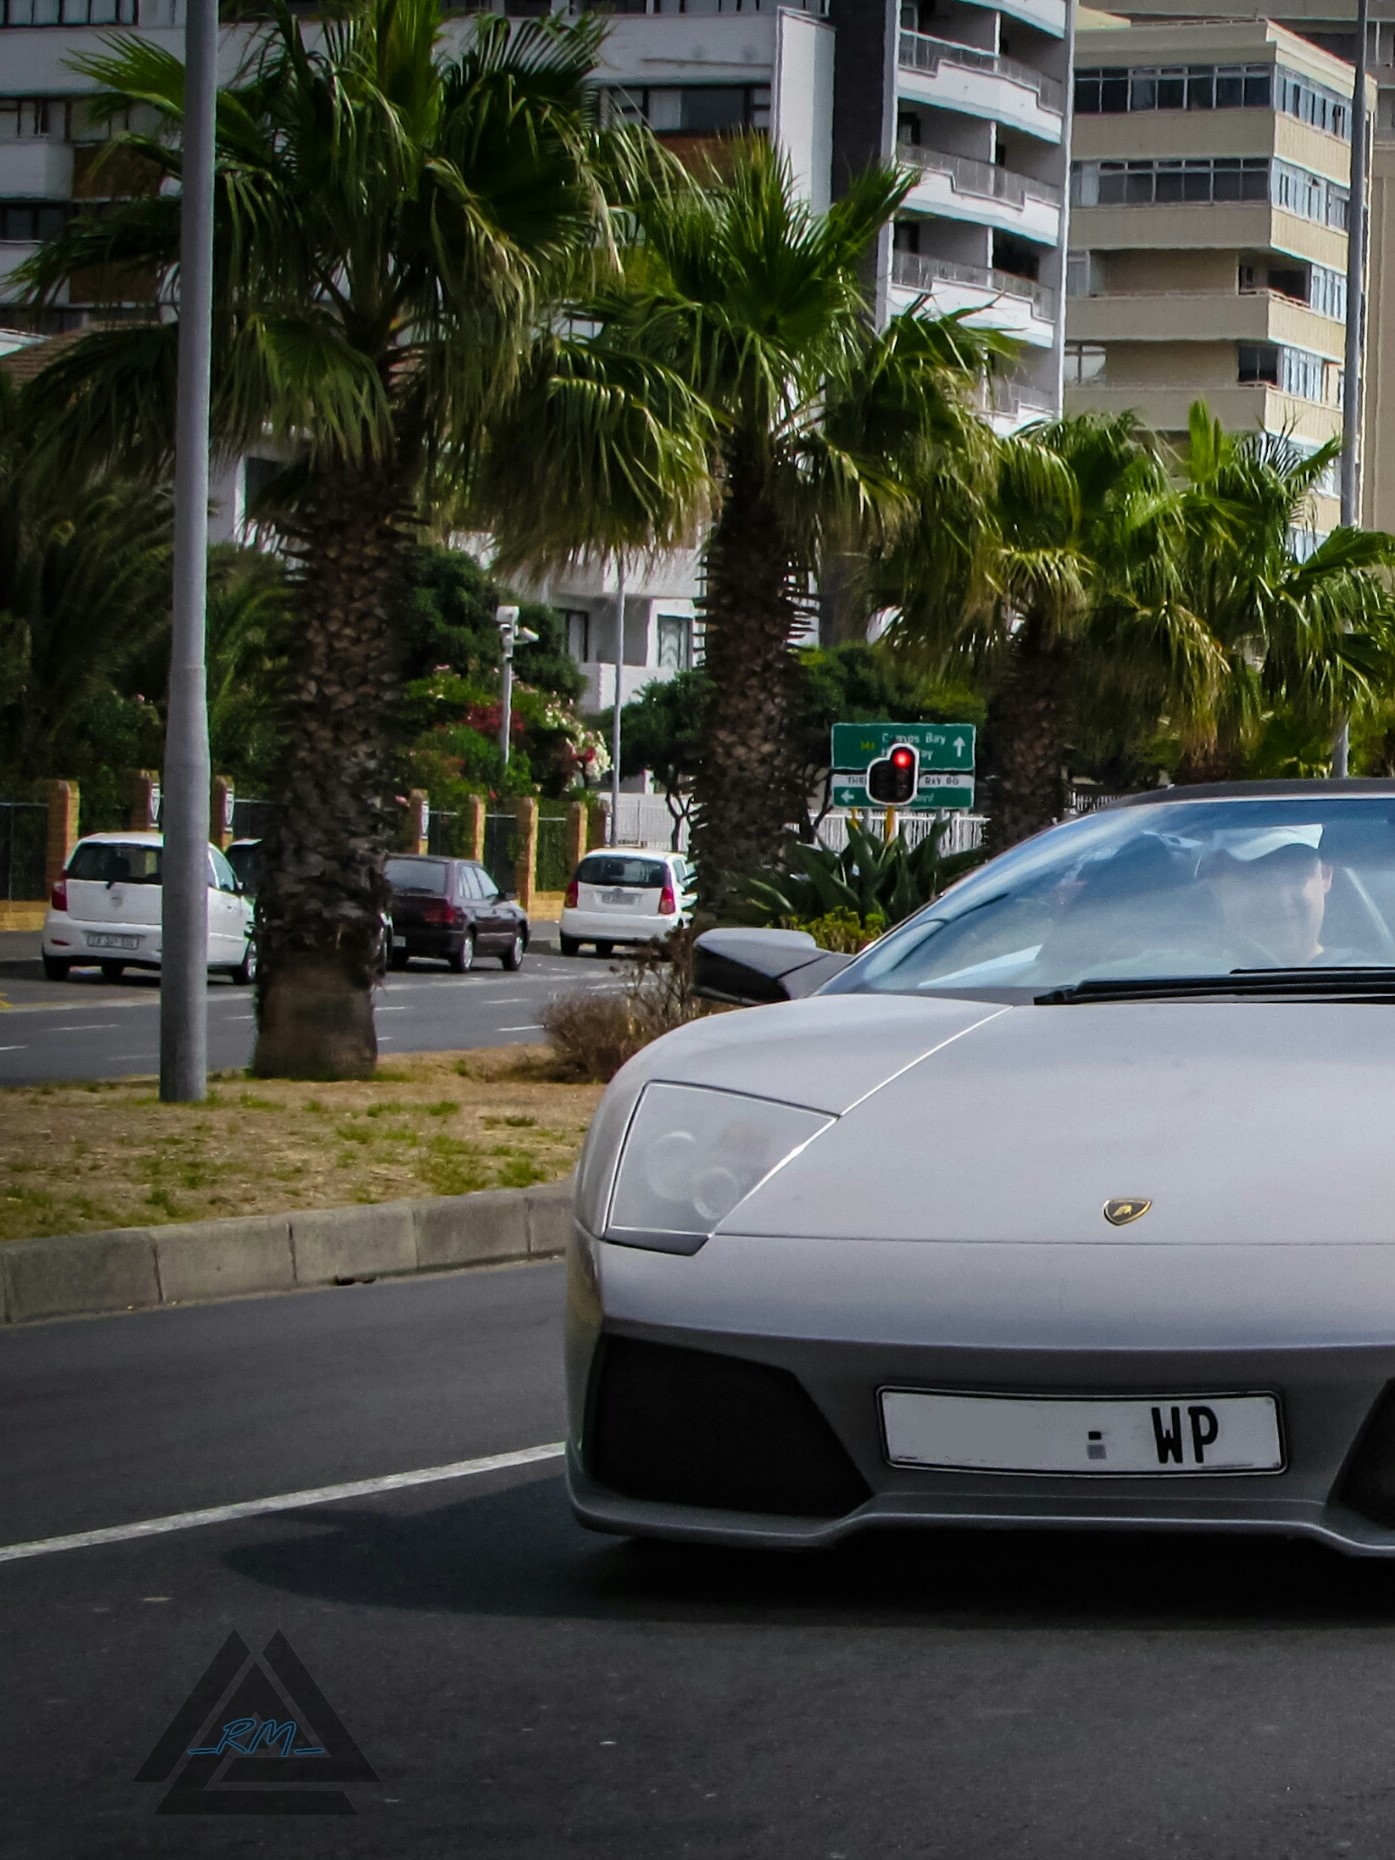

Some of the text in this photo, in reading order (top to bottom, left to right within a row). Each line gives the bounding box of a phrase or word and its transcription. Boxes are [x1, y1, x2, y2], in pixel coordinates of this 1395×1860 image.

[881, 732, 946, 746] Cmps Bay
[1151, 1405, 1220, 1464] WP
